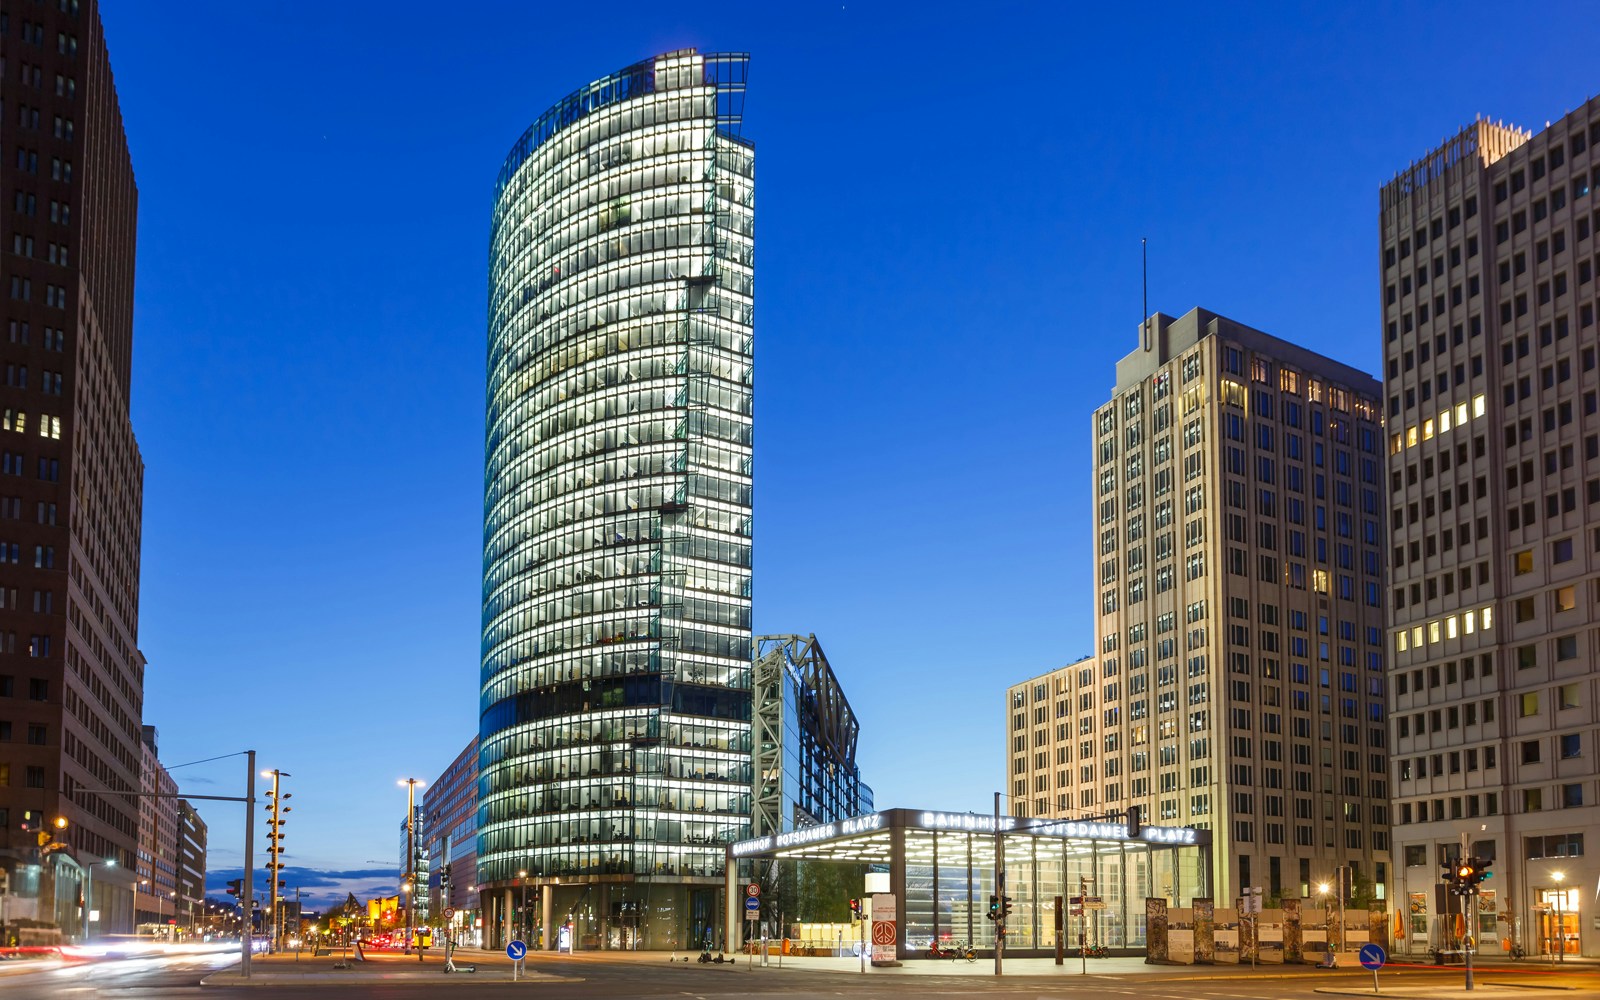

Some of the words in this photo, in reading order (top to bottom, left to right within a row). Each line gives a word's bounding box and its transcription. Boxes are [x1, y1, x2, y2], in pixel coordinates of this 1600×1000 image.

[732, 838, 770, 855] BAHNHOF
[776, 825, 833, 847] POTSDAMER
[842, 814, 880, 834] PLATZ
[922, 812, 1015, 831] BAHNHOF
[1147, 827, 1195, 842] PLATZ
